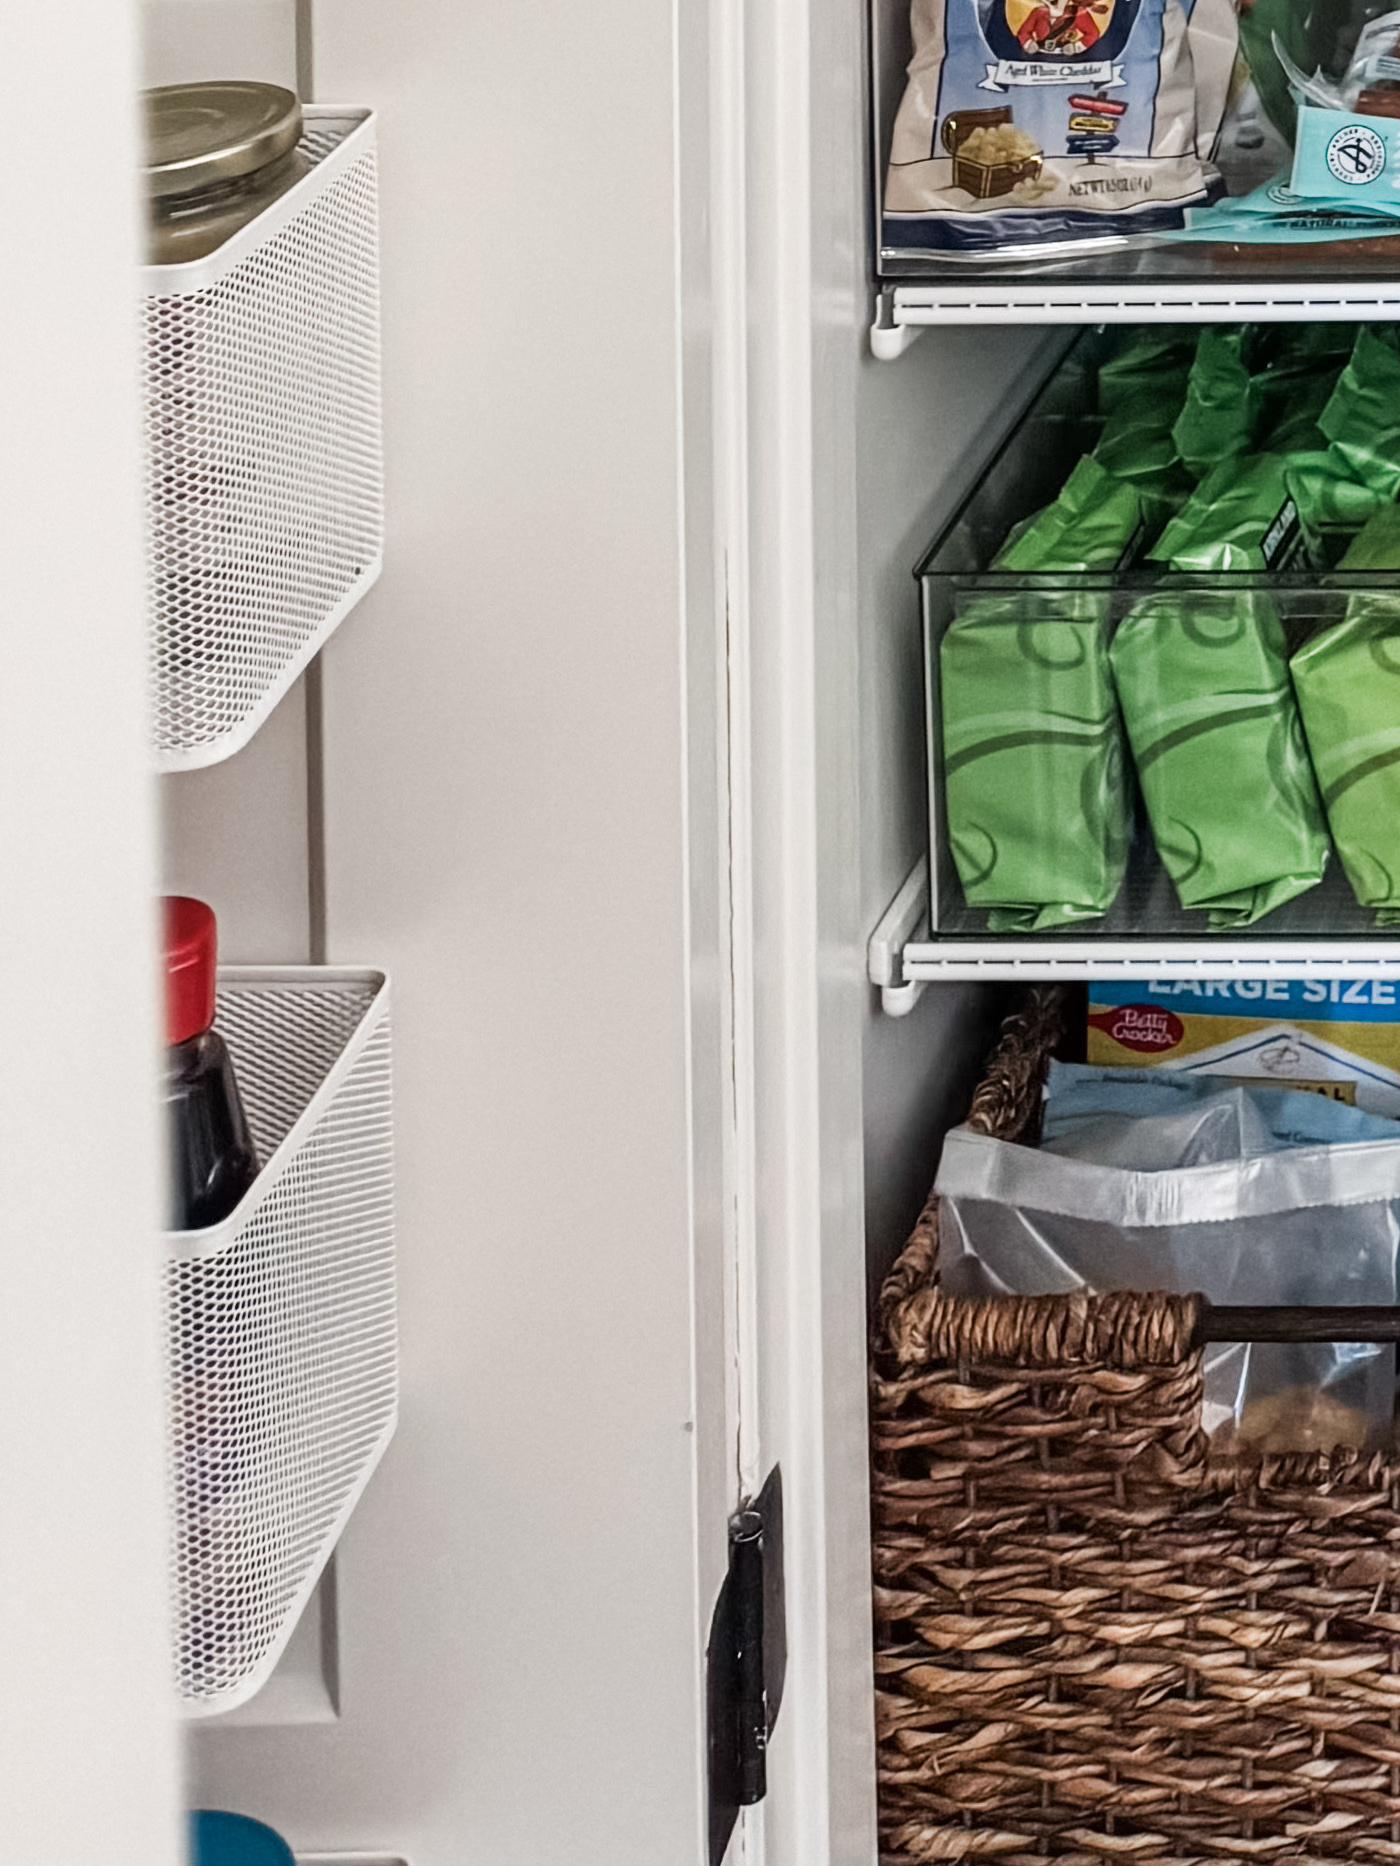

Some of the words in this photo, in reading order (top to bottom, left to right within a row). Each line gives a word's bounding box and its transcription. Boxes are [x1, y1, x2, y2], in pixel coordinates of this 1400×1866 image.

[1149, 980, 1289, 1001] LARGE
[1302, 980, 1396, 1005] SIZE
[1122, 1010, 1168, 1032] Betty
[1112, 1025, 1177, 1045] Crocker
